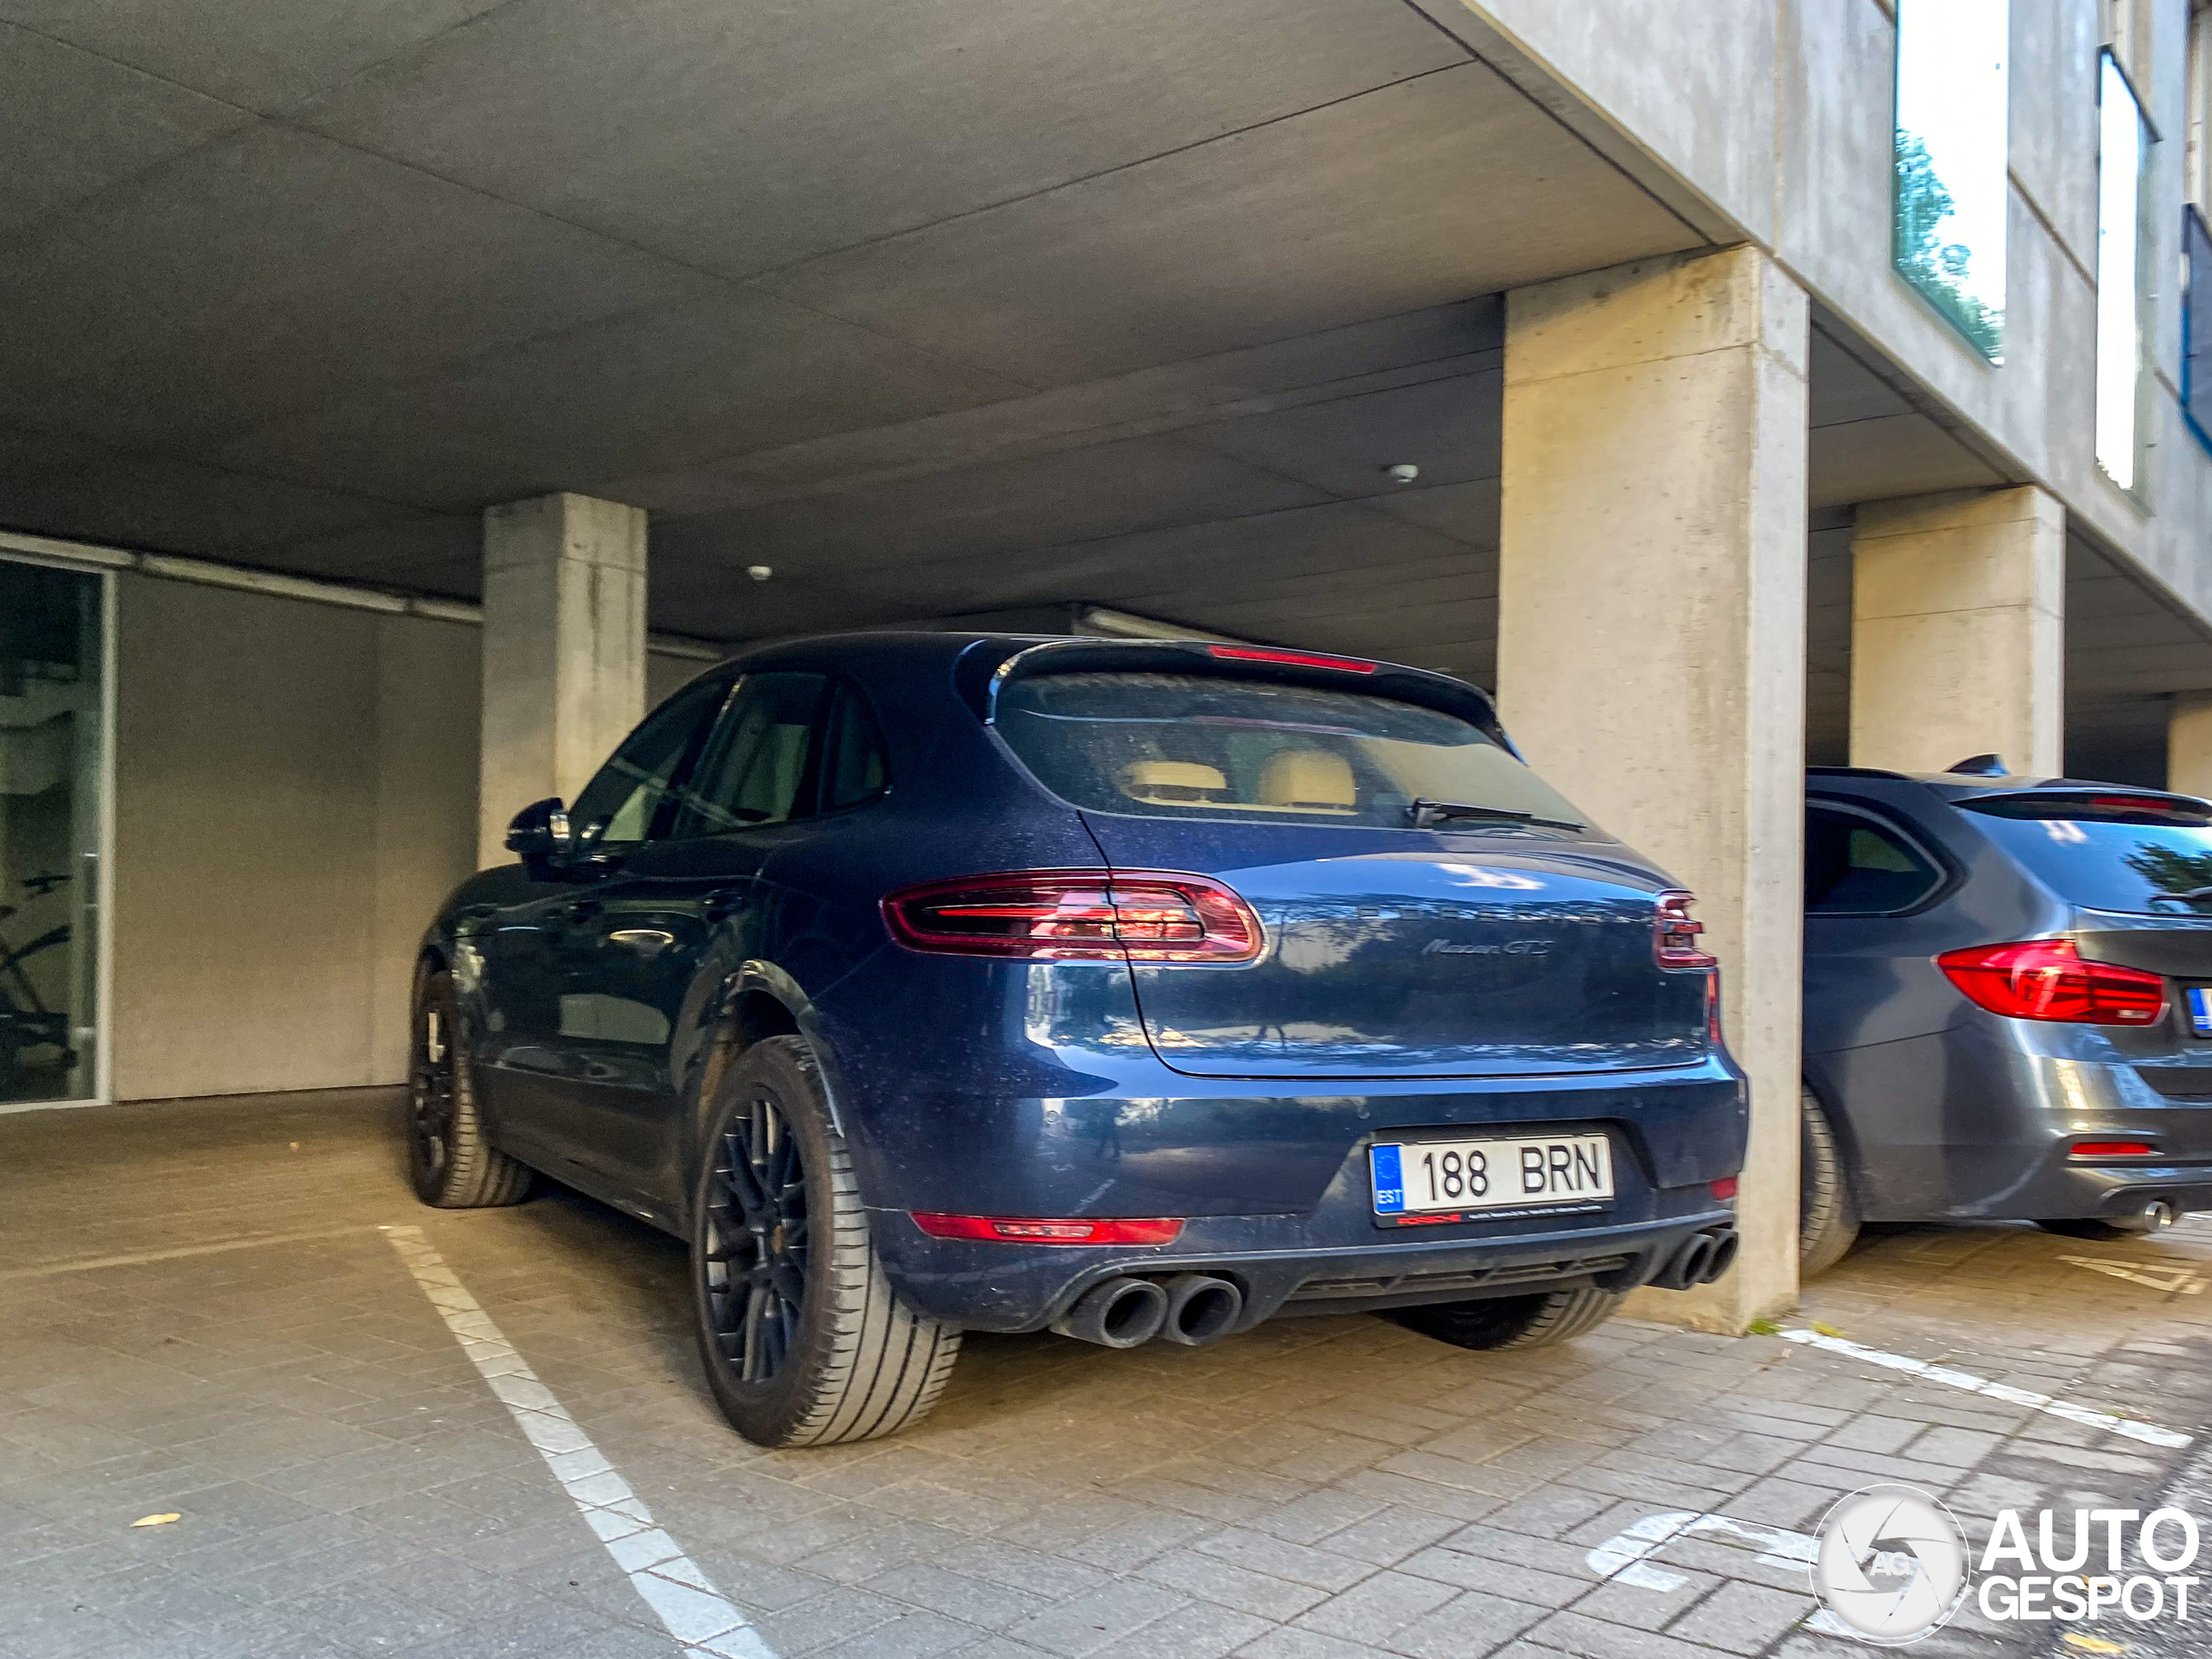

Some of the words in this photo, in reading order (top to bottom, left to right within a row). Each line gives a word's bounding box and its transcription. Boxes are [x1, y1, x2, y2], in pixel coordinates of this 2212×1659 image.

[1424, 1149, 1488, 1201] 188
[1519, 1142, 1602, 1193] BRN
[1377, 1189, 1402, 1204] EST
